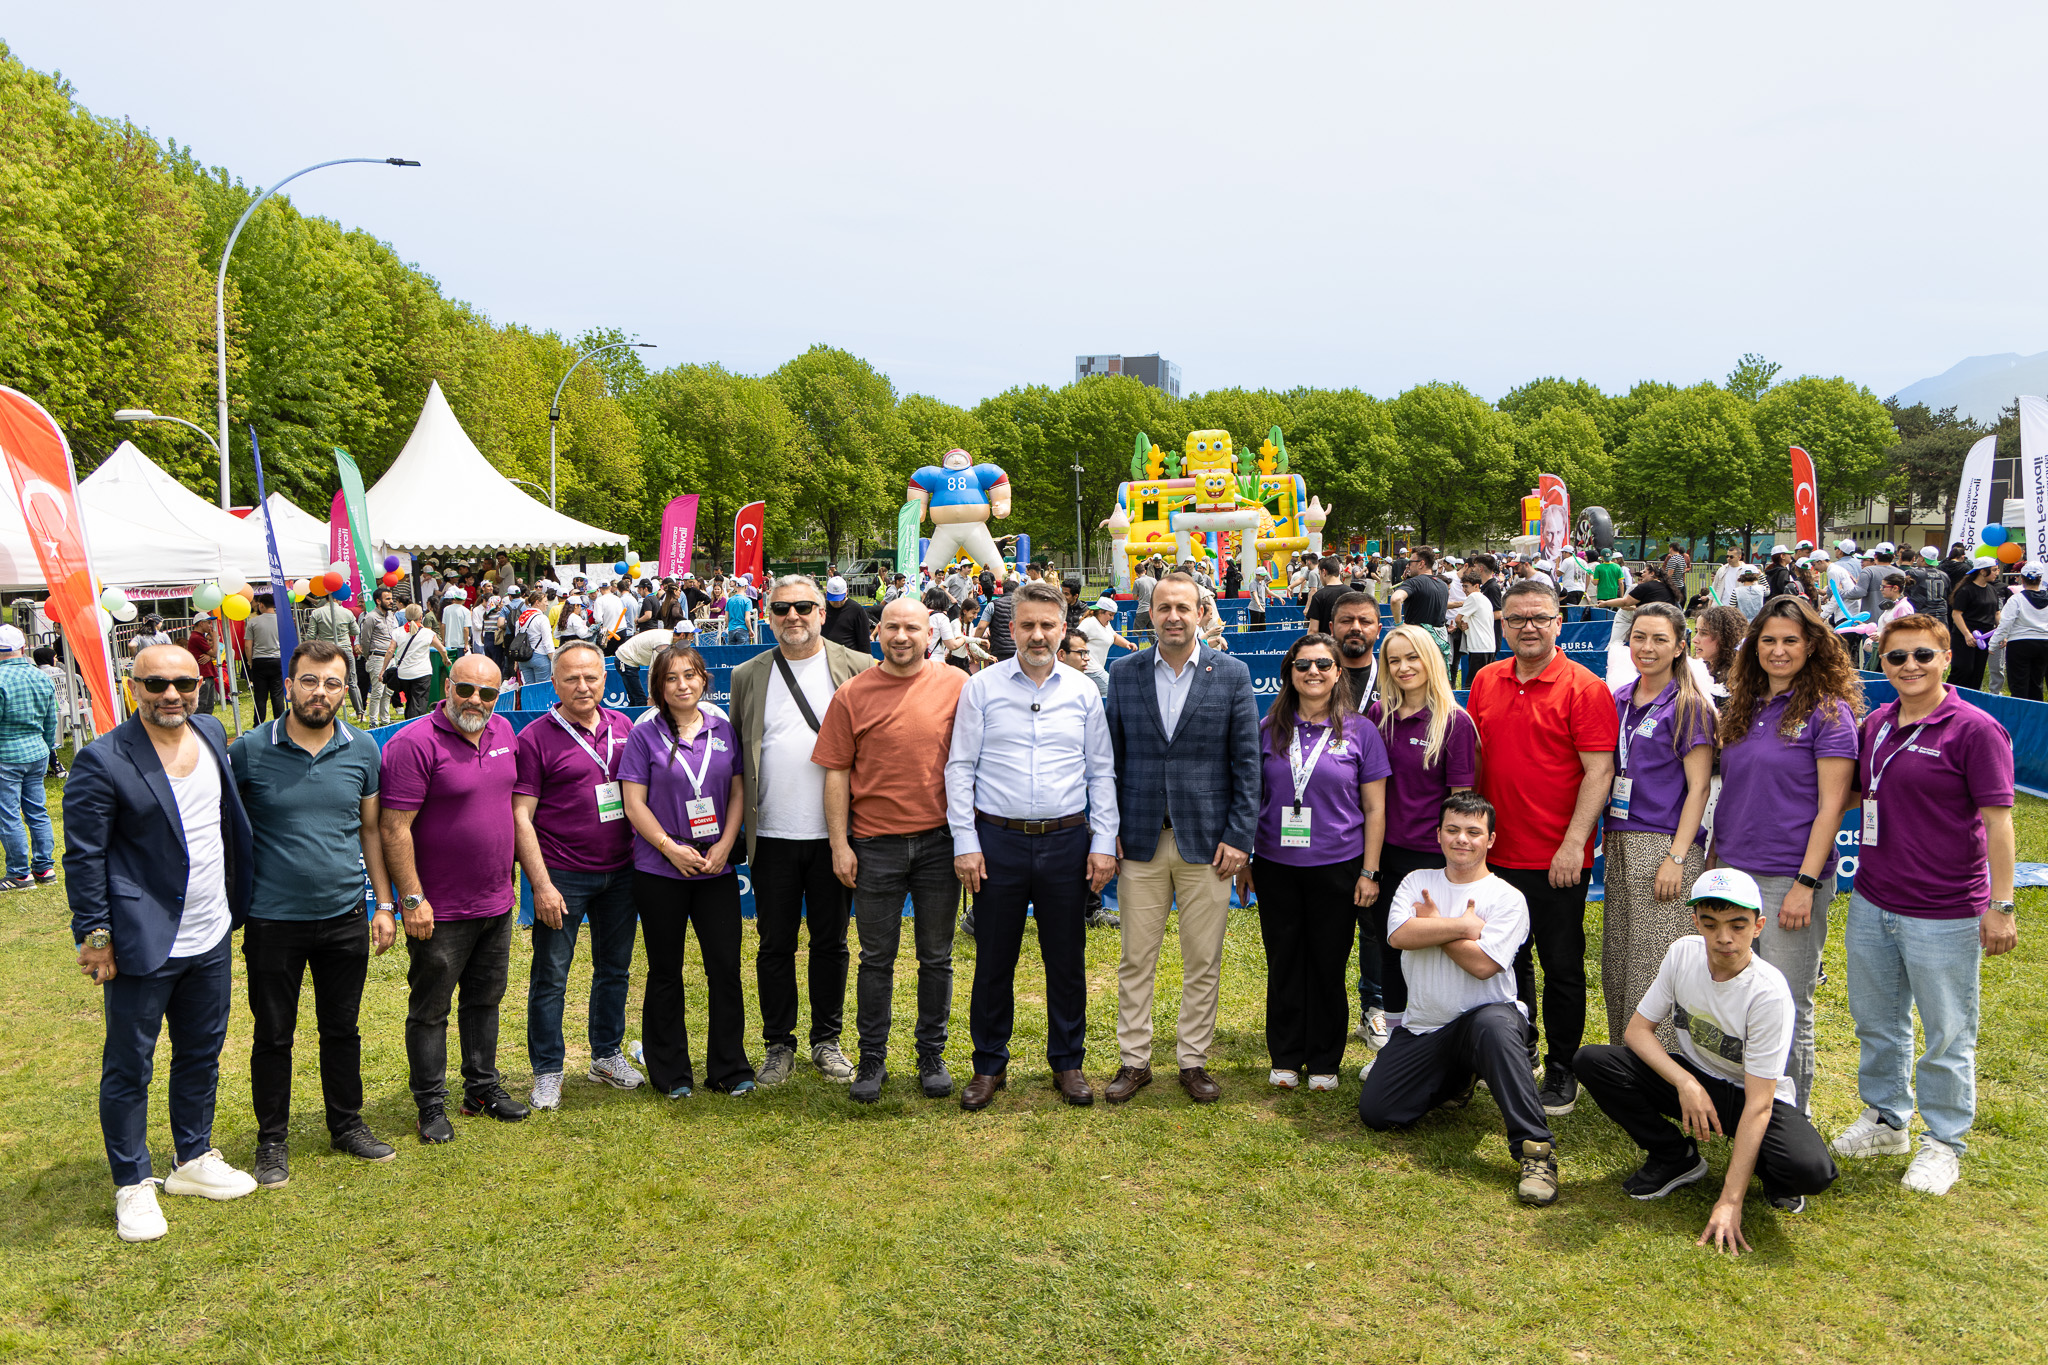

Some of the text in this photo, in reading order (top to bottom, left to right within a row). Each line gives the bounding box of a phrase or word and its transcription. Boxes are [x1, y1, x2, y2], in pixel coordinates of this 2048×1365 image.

[947, 477, 967, 491] 88
[1965, 478, 1982, 552] Spor Festivali
[341, 528, 350, 566] estivali
[676, 527, 688, 564] Festivali
[1925, 579, 1945, 601] 10
